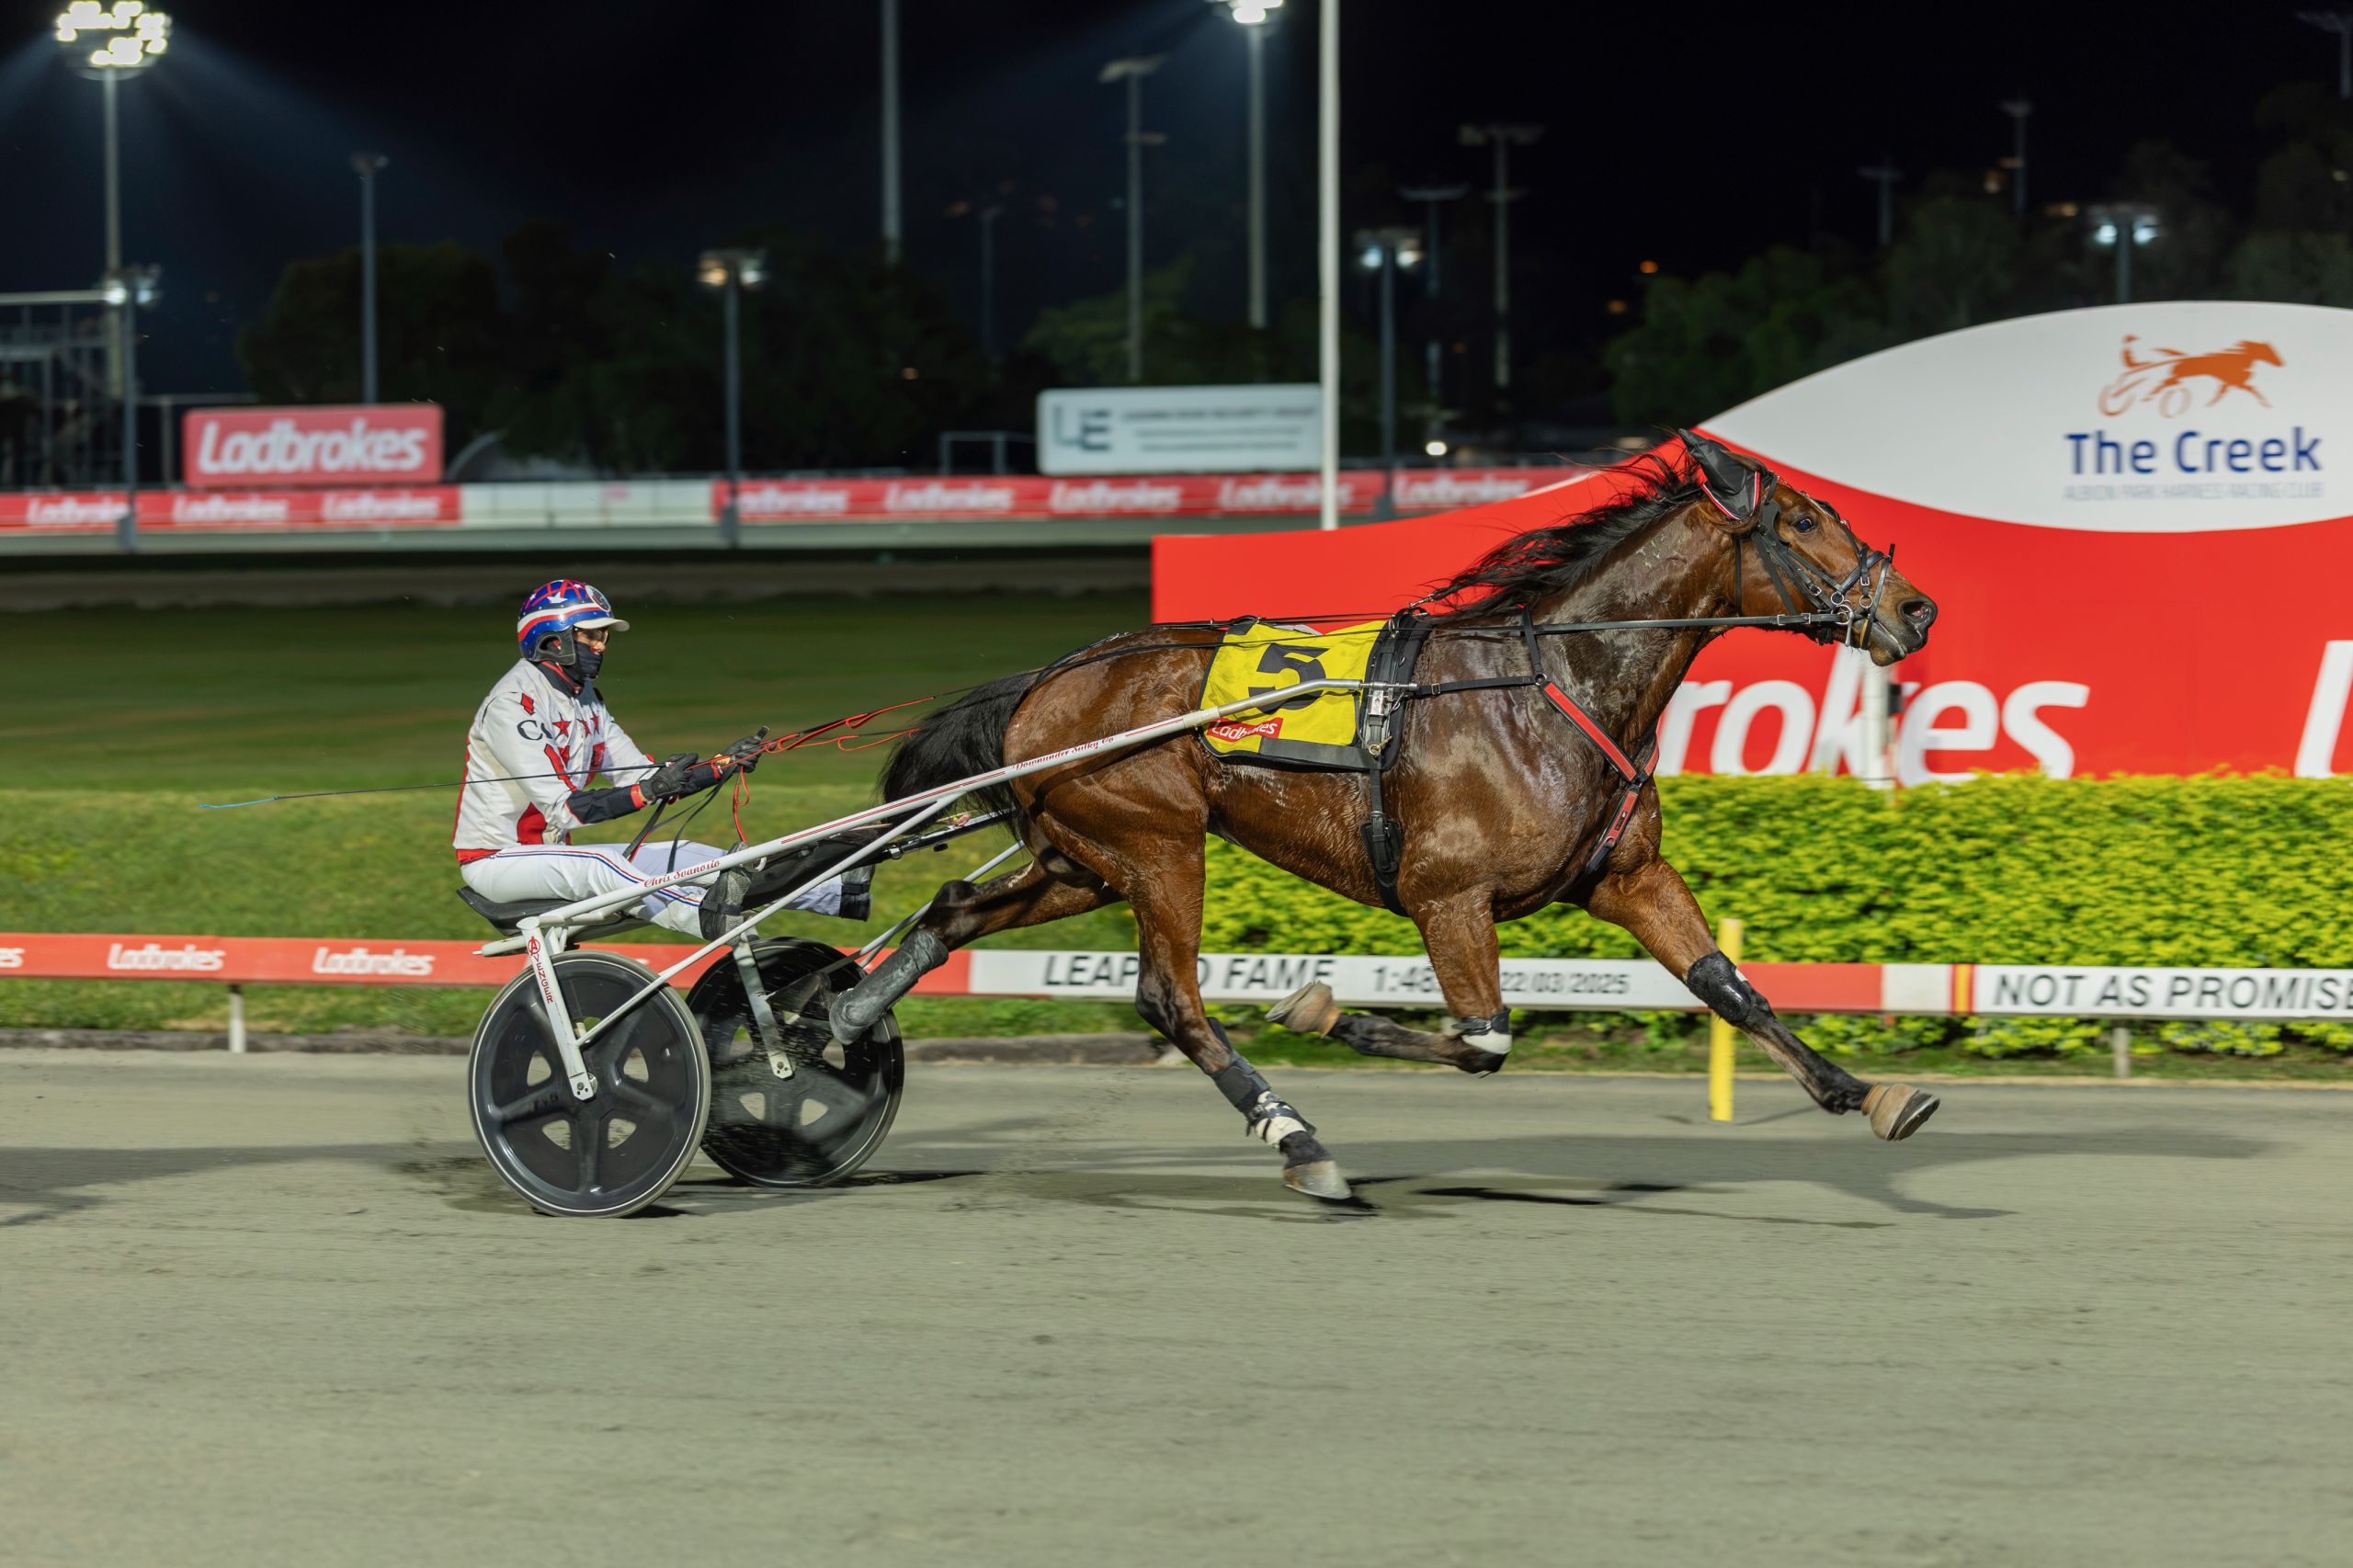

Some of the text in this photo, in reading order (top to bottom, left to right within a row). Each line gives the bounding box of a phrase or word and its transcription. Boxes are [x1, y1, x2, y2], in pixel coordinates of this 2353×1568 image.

[199, 417, 427, 474] Ladbrokes
[2063, 426, 2322, 474] The Creek
[1248, 643, 1329, 714] 5
[643, 872, 671, 888] Chris
[107, 943, 226, 971] Ladbrokes
[313, 948, 435, 976] Ladbrokes
[1223, 957, 1336, 990] FAME
[1993, 974, 2086, 1006] NOT
[2096, 975, 2152, 1008] AS
